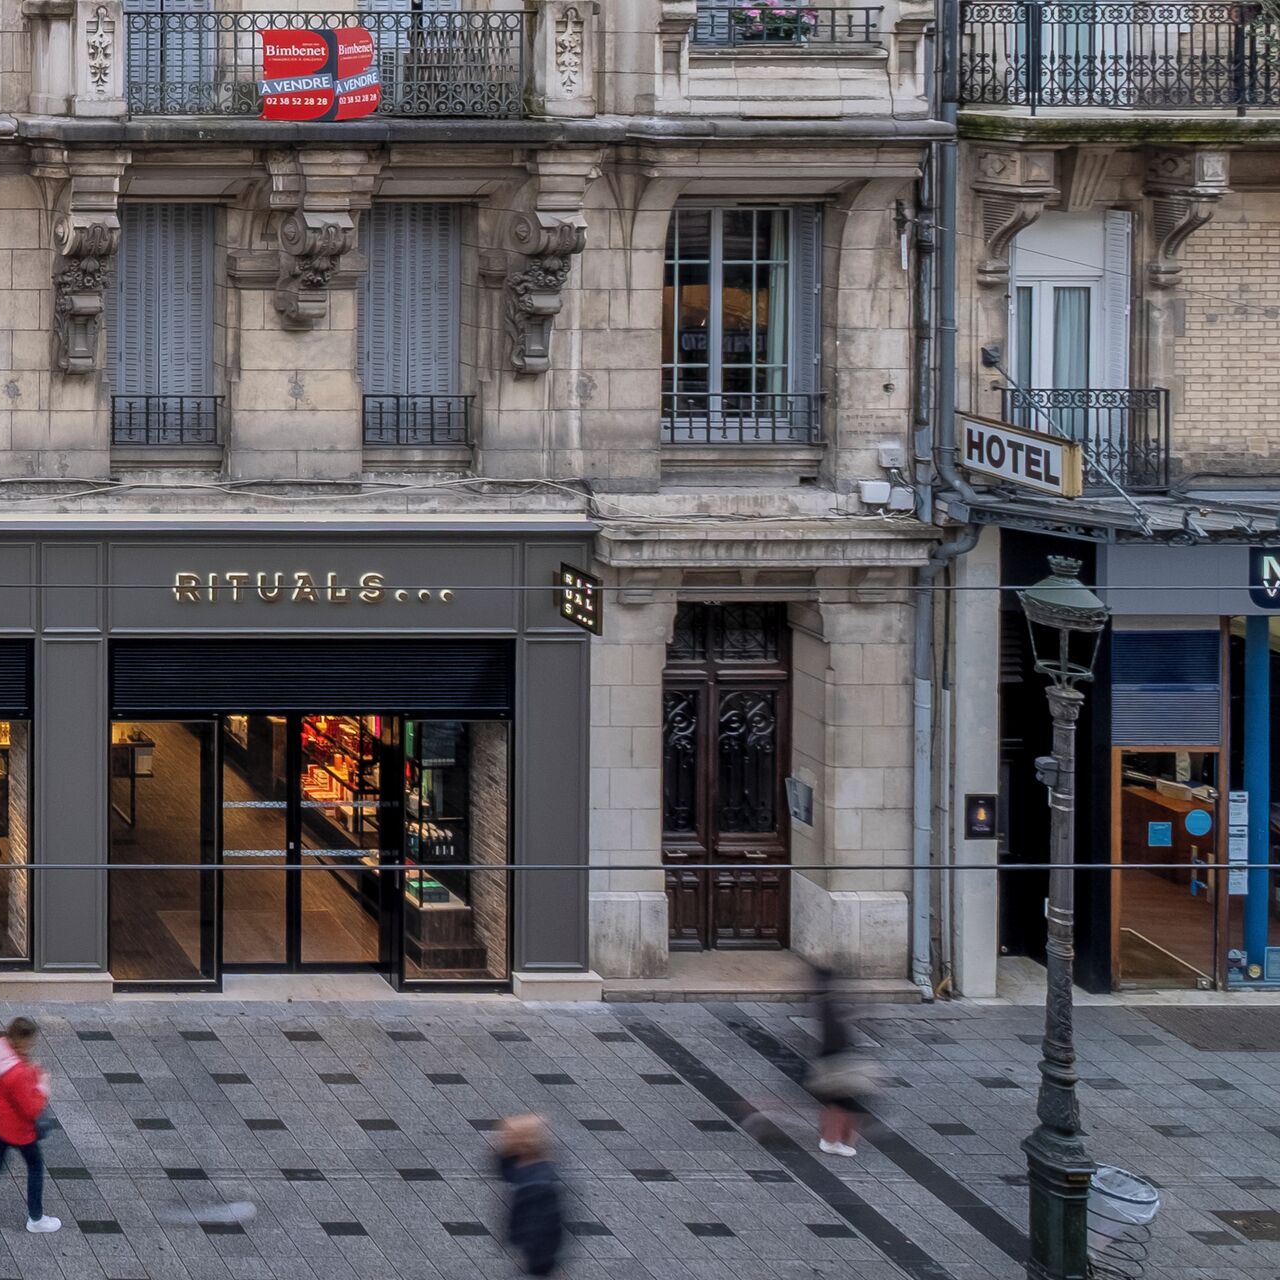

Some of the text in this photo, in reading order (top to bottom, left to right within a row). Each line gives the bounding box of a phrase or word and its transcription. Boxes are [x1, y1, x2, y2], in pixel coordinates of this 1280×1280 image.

[266, 45, 326, 56] Bimbenet
[338, 43, 373, 55] Bimbenet
[261, 76, 331, 94] À VENDRE
[336, 72, 378, 94] À VENDRE
[266, 97, 328, 106] 02 38 52 28 28
[967, 428, 1060, 486] HOTEL
